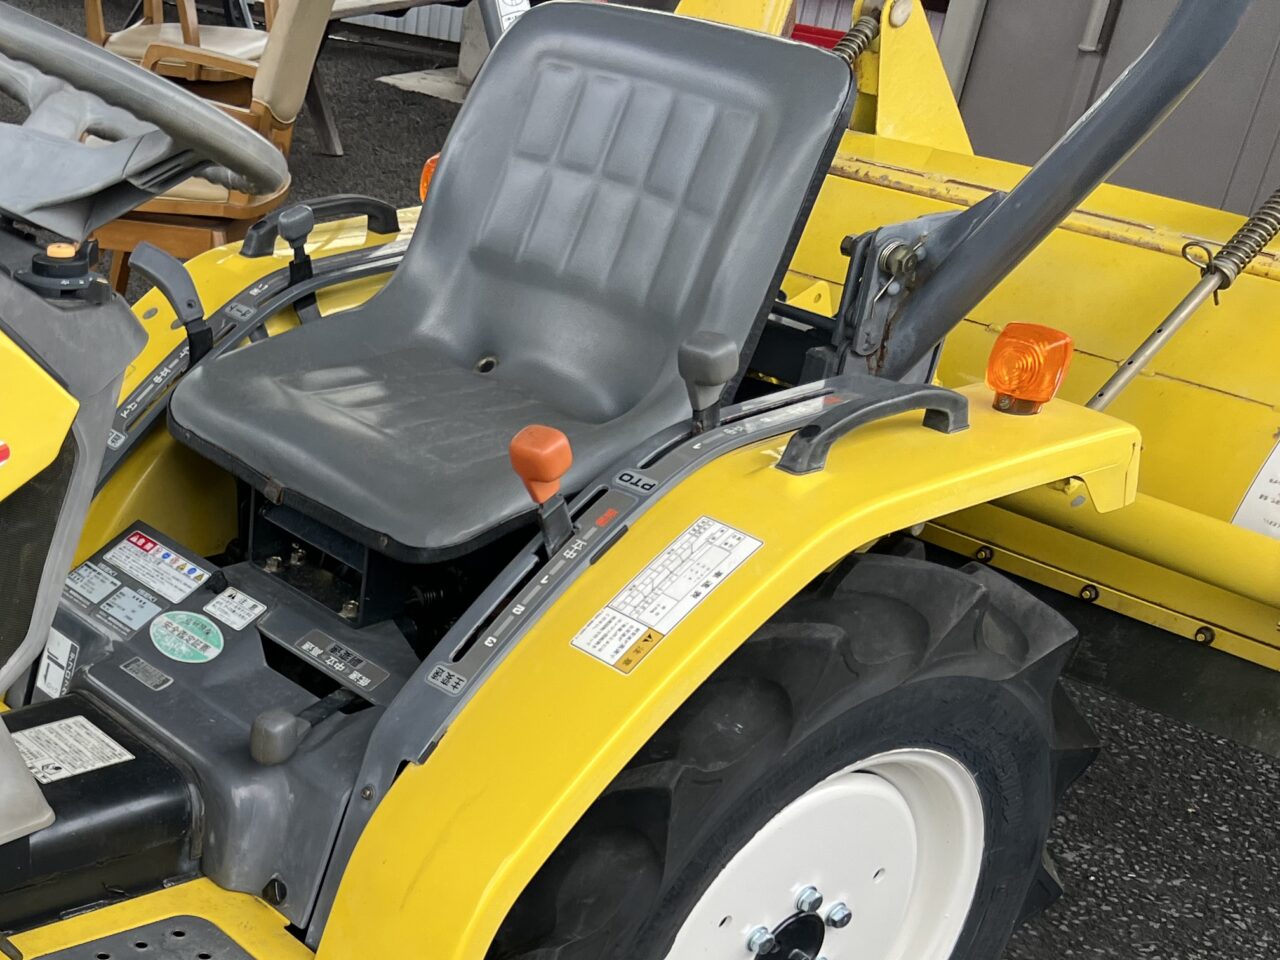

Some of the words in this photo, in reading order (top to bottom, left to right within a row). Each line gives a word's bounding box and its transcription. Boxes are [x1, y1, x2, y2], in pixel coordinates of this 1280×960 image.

[618, 471, 657, 492] PTO
[563, 539, 587, 559] 中立
[512, 604, 525, 615] 2
[484, 636, 497, 647] 3
[325, 655, 346, 672] 中立
[431, 666, 465, 691] 主変速
